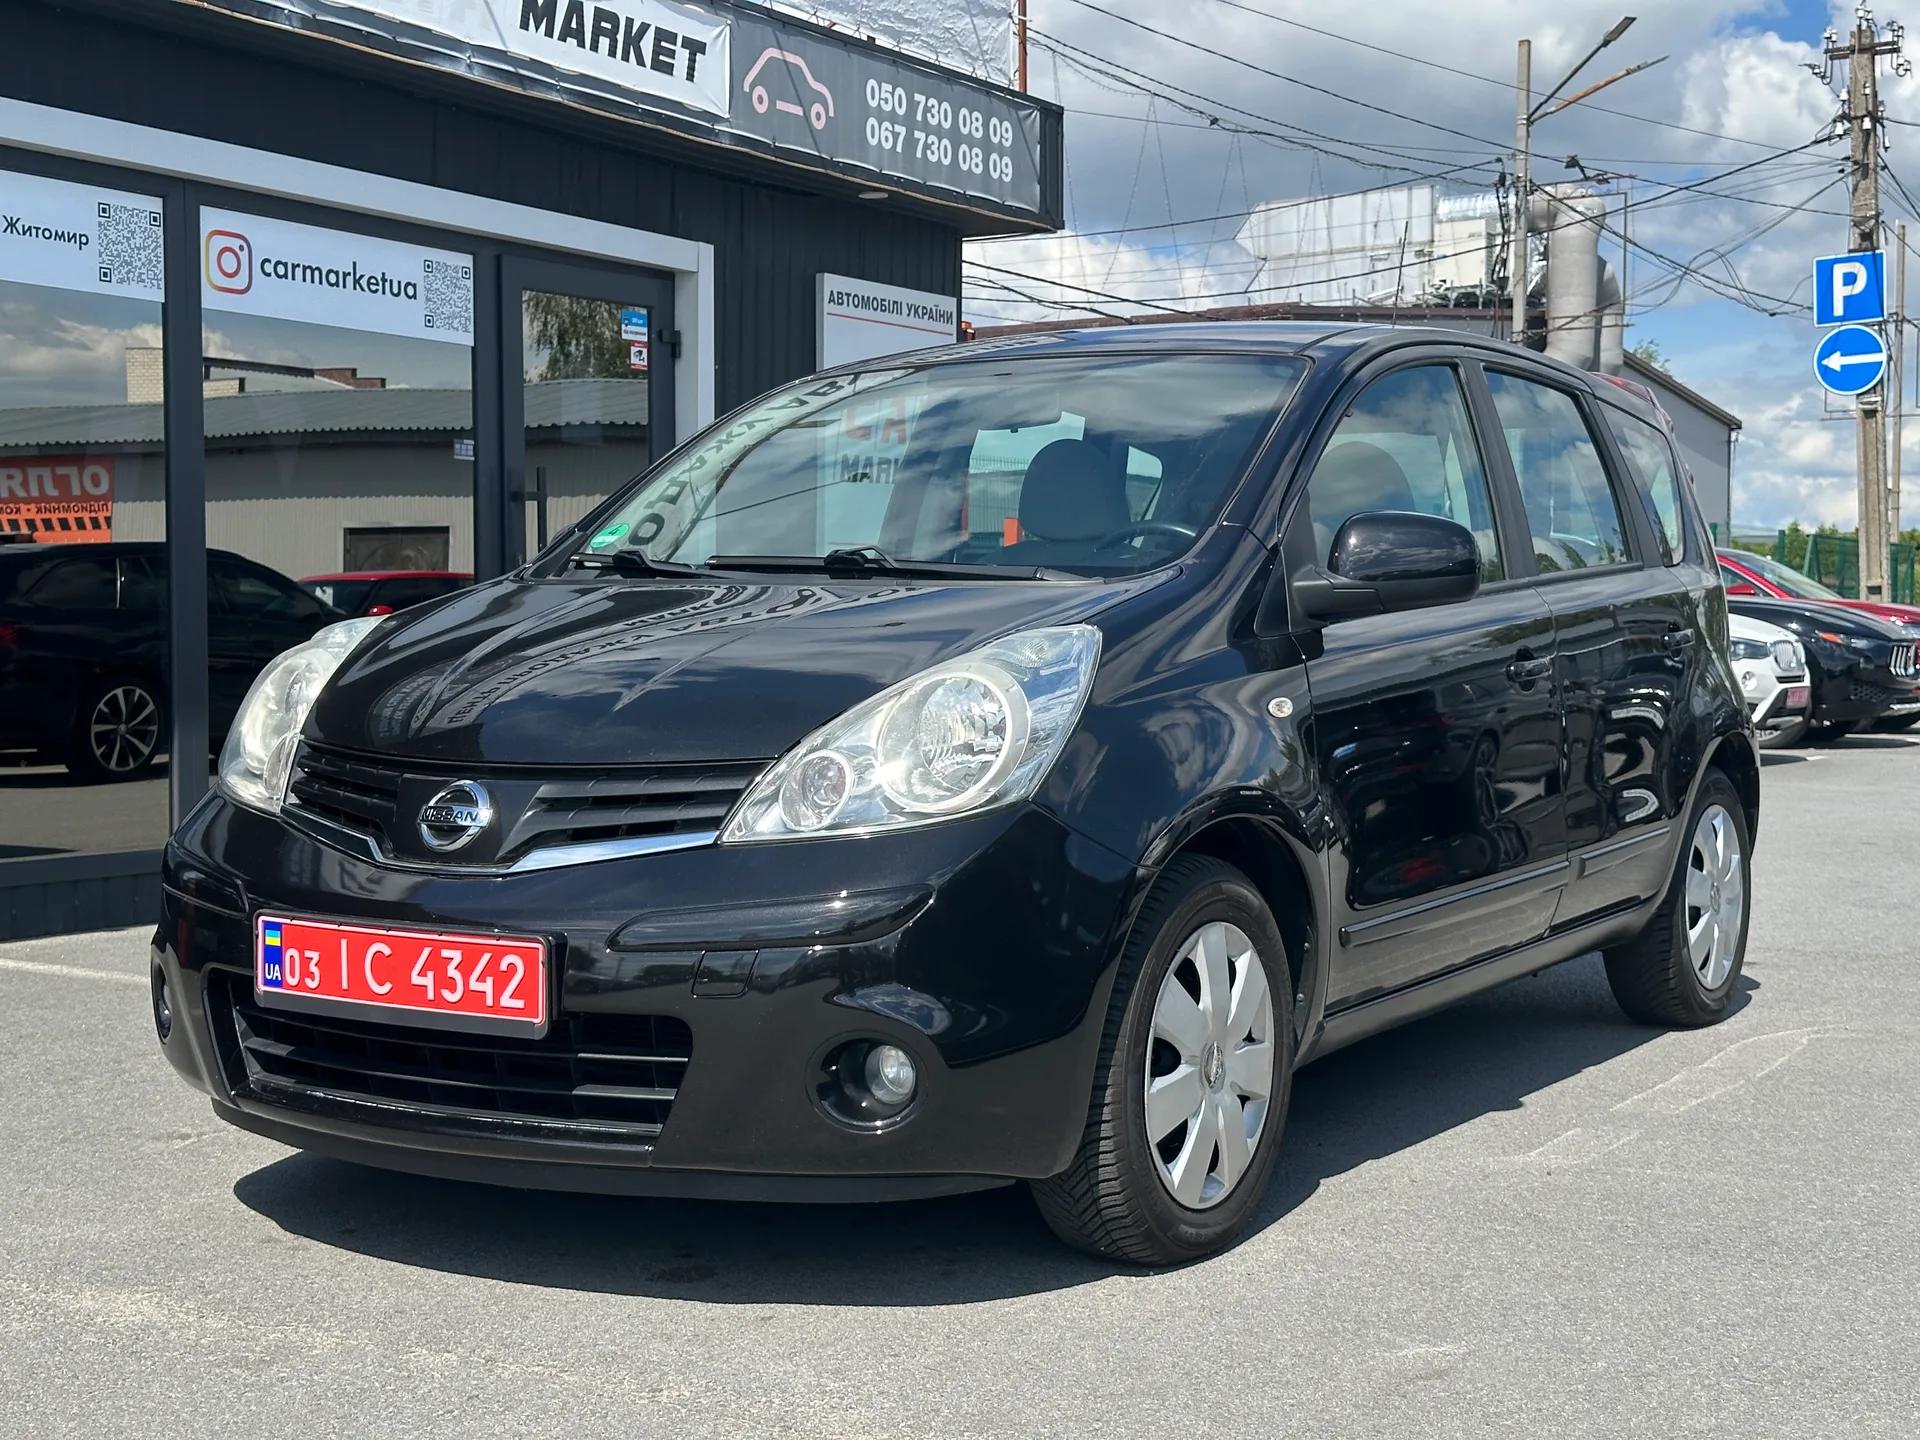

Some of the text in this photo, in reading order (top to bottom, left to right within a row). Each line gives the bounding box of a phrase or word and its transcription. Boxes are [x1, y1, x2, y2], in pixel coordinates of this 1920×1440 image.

[519, 0, 707, 82] MARKET
[866, 78, 1013, 147] 050 730 08 09
[866, 116, 1013, 182] 067 730 08 09
[2, 214, 90, 251] Житомир
[259, 255, 418, 300] carmarketua
[1832, 262, 1867, 317] P
[827, 289, 953, 326] АВТОМОБІЛІ УКРАЇНИ
[420, 806, 479, 822] NISSAN
[265, 963, 281, 981] UA
[285, 947, 321, 989] 03
[410, 946, 525, 1009] 4342
